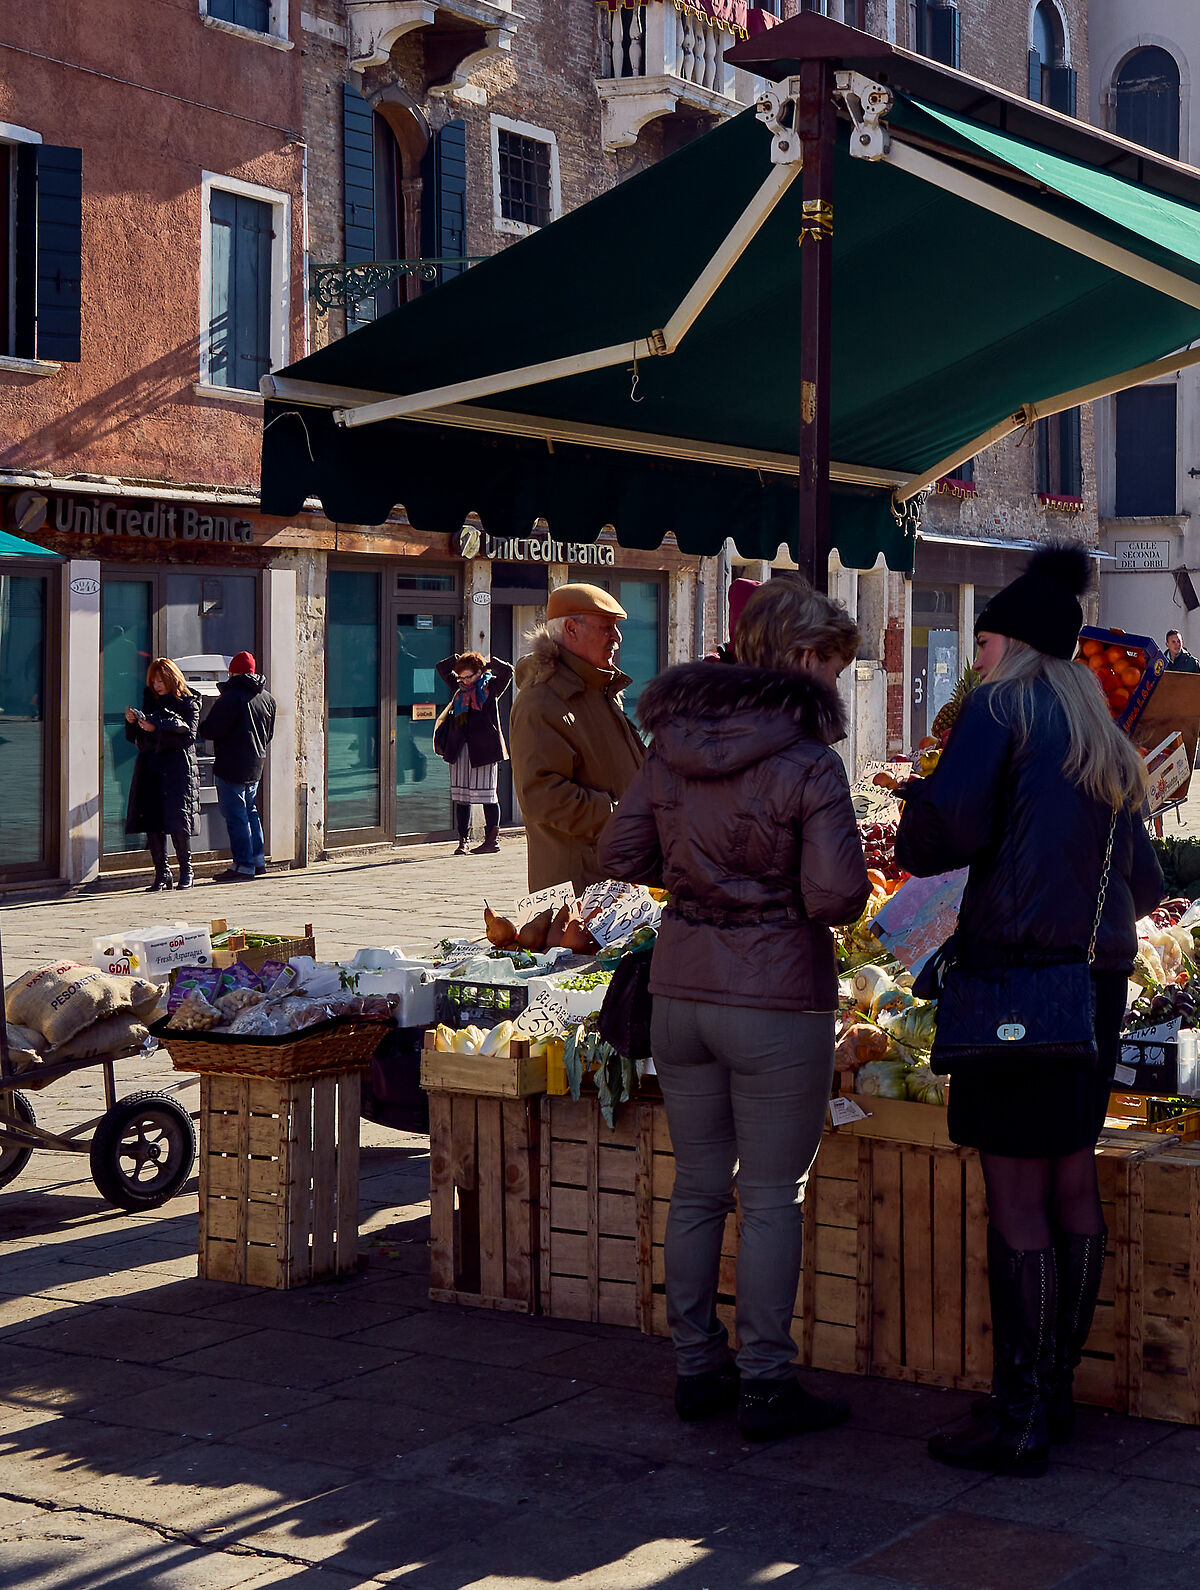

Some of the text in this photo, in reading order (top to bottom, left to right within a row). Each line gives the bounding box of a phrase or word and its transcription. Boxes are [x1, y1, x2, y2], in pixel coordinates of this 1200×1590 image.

[55, 498, 255, 543] UniCredit Banca
[567, 542, 615, 566] Banca
[1128, 542, 1157, 550] CALLE
[1122, 551, 1160, 559] SECONDA
[1121, 560, 1163, 568] DEI ORBI
[517, 888, 557, 912] KAISER
[168, 939, 186, 949] GDM
[155, 949, 203, 965] Fresh Asparagus
[108, 962, 131, 975] GDM
[50, 984, 78, 1011] PESO
[535, 990, 563, 1017] BELGA
